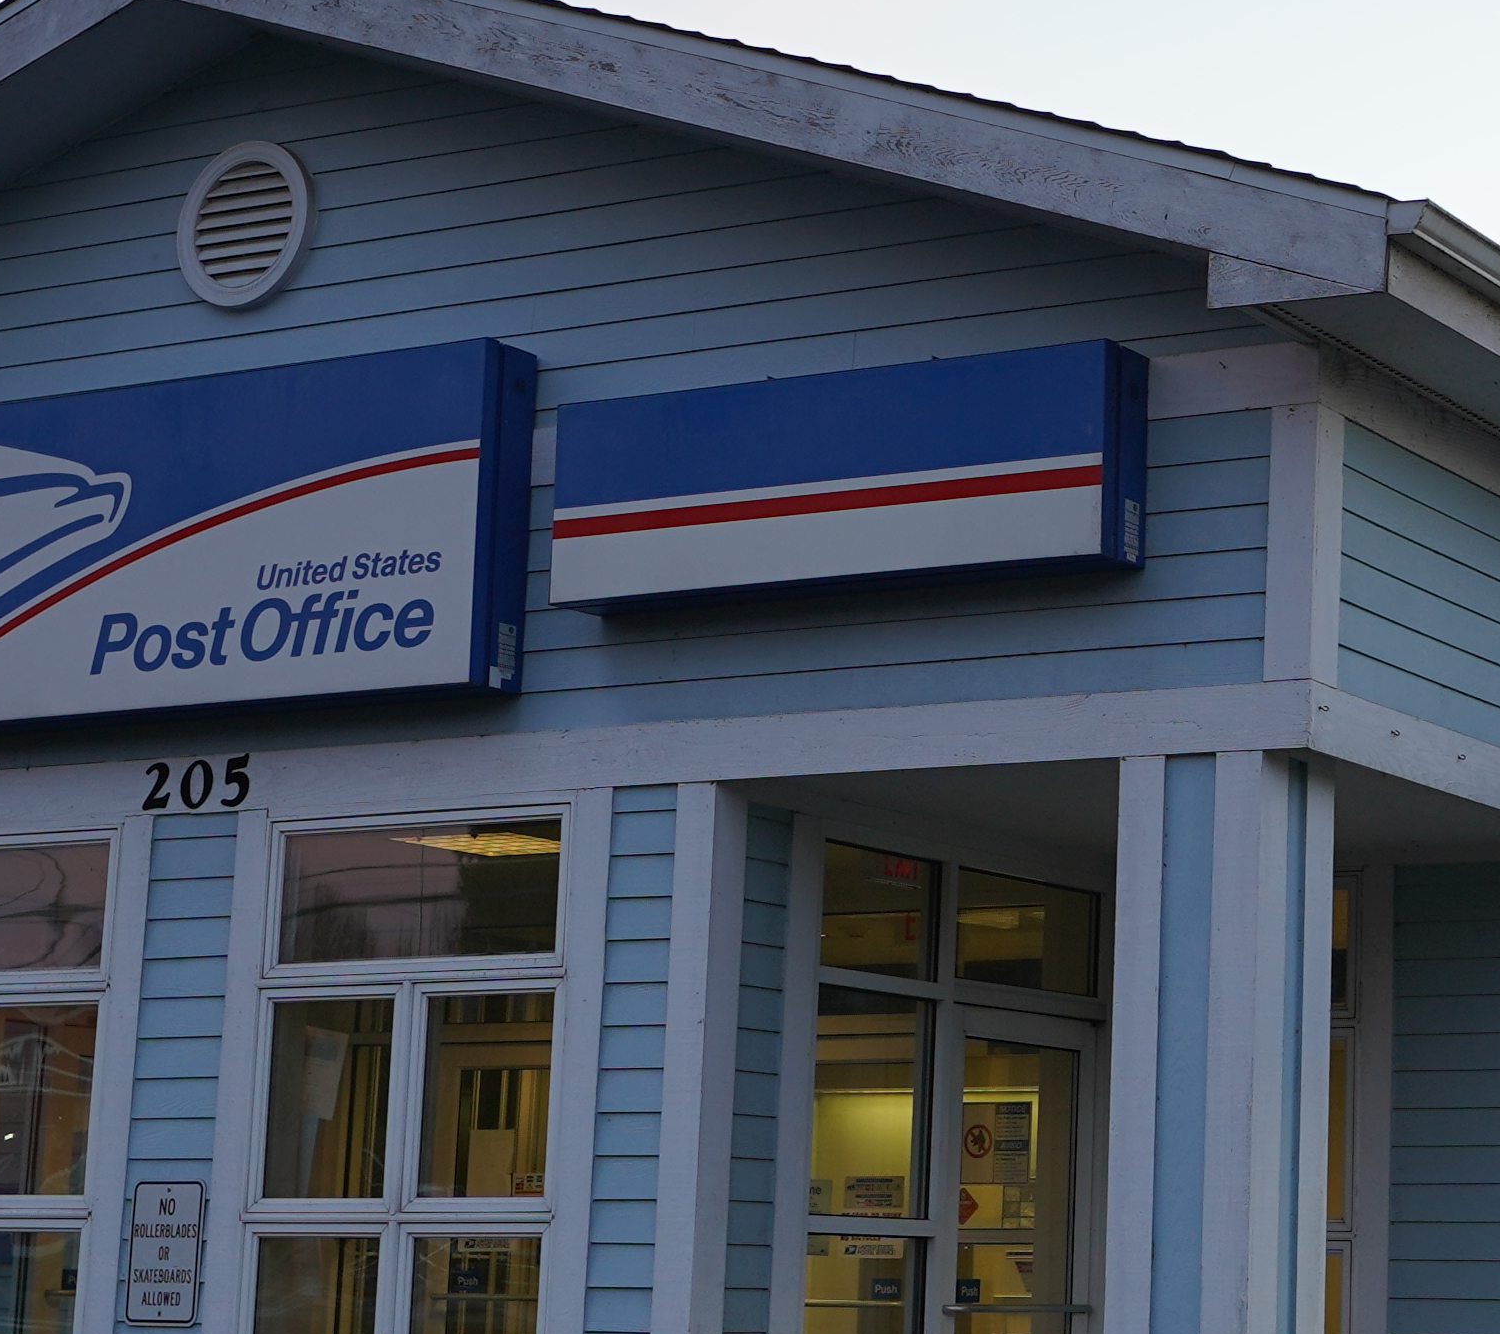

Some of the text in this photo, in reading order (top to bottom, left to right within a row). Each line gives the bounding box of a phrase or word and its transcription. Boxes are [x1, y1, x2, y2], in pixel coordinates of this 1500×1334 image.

[257, 549, 442, 590] United States
[90, 606, 236, 675] Post
[240, 589, 435, 662] Office
[142, 753, 250, 811] 205
[158, 1198, 176, 1216] NO
[134, 1223, 198, 1239] ROLLERBLADES
[158, 1245, 170, 1261] OR
[133, 1268, 193, 1284] SKATEBOARDS
[457, 1276, 479, 1287] Push
[874, 1283, 898, 1294] Push
[961, 1285, 979, 1297] Push
[141, 1291, 181, 1307] ALLOWED
